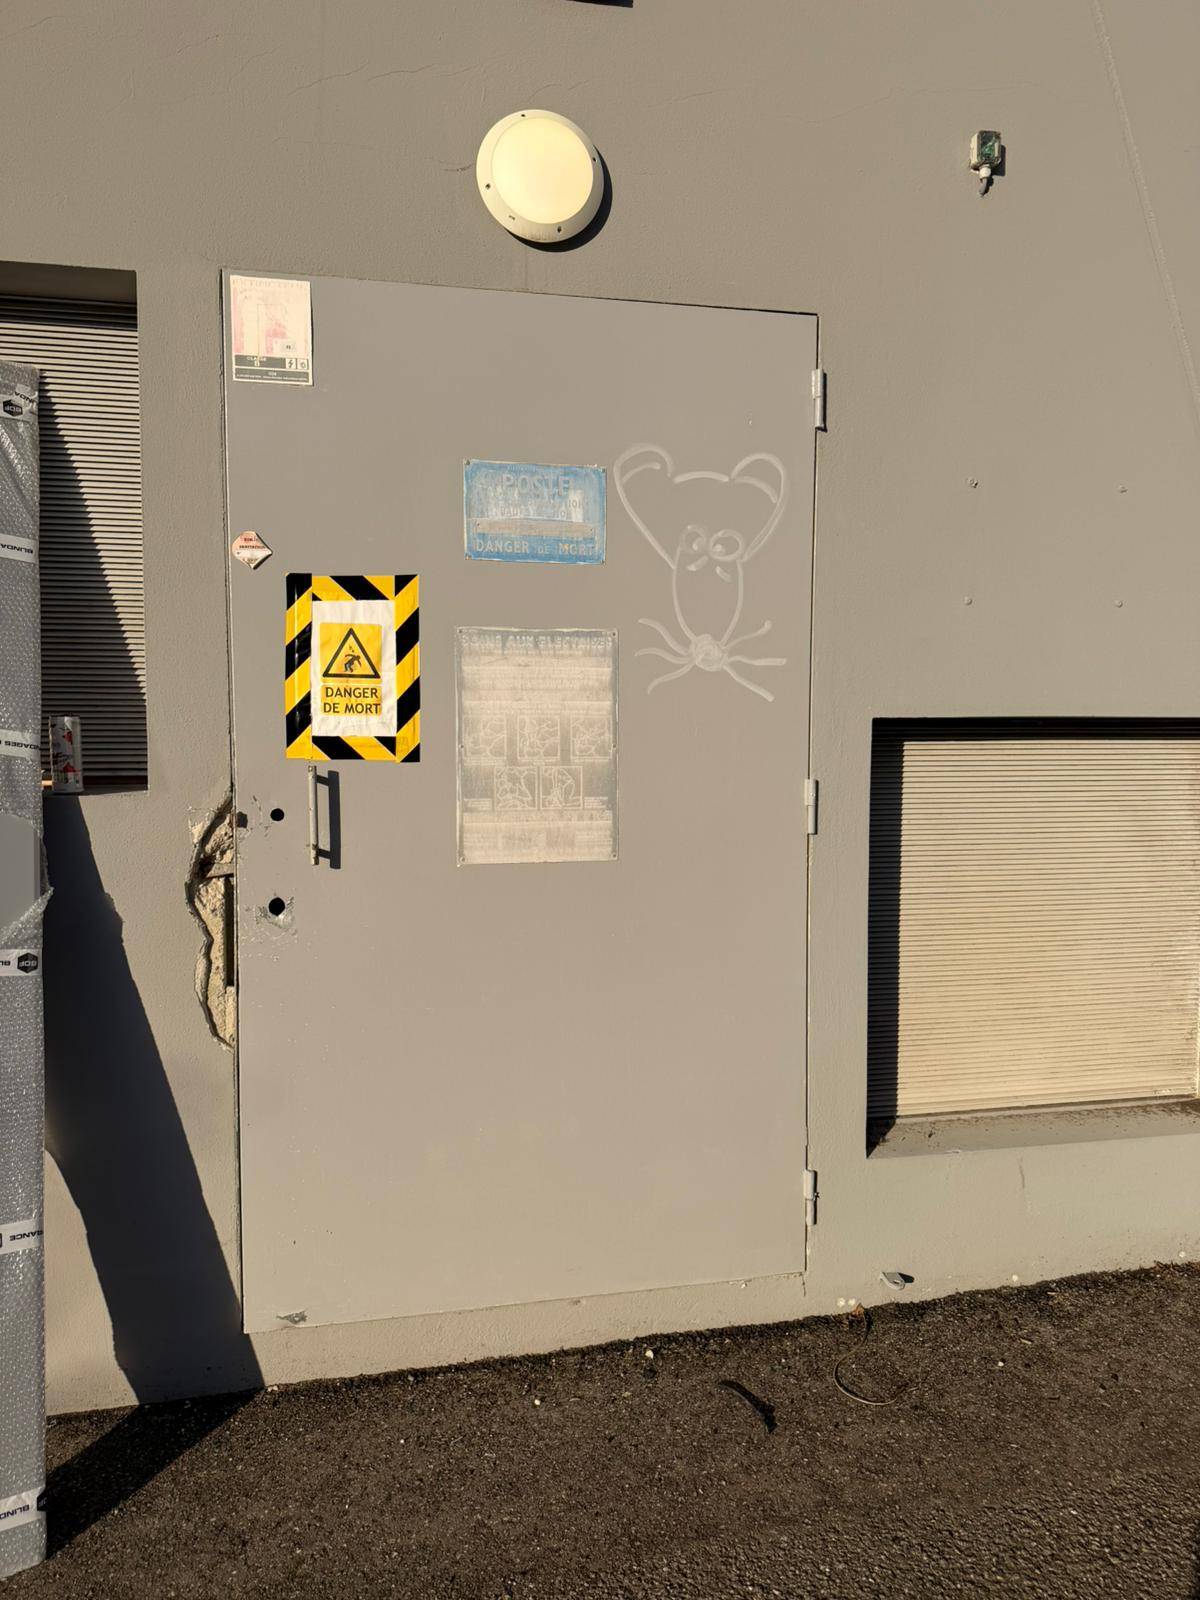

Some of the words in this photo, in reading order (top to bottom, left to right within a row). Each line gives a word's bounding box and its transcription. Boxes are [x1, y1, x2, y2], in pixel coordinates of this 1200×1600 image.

[501, 473, 571, 498] POSTE
[475, 540, 530, 554] DANGER
[537, 543, 550, 555] DE
[558, 543, 596, 556] MORT
[325, 686, 379, 699] DANGER
[323, 702, 340, 714] DE
[344, 703, 381, 715] MORT
